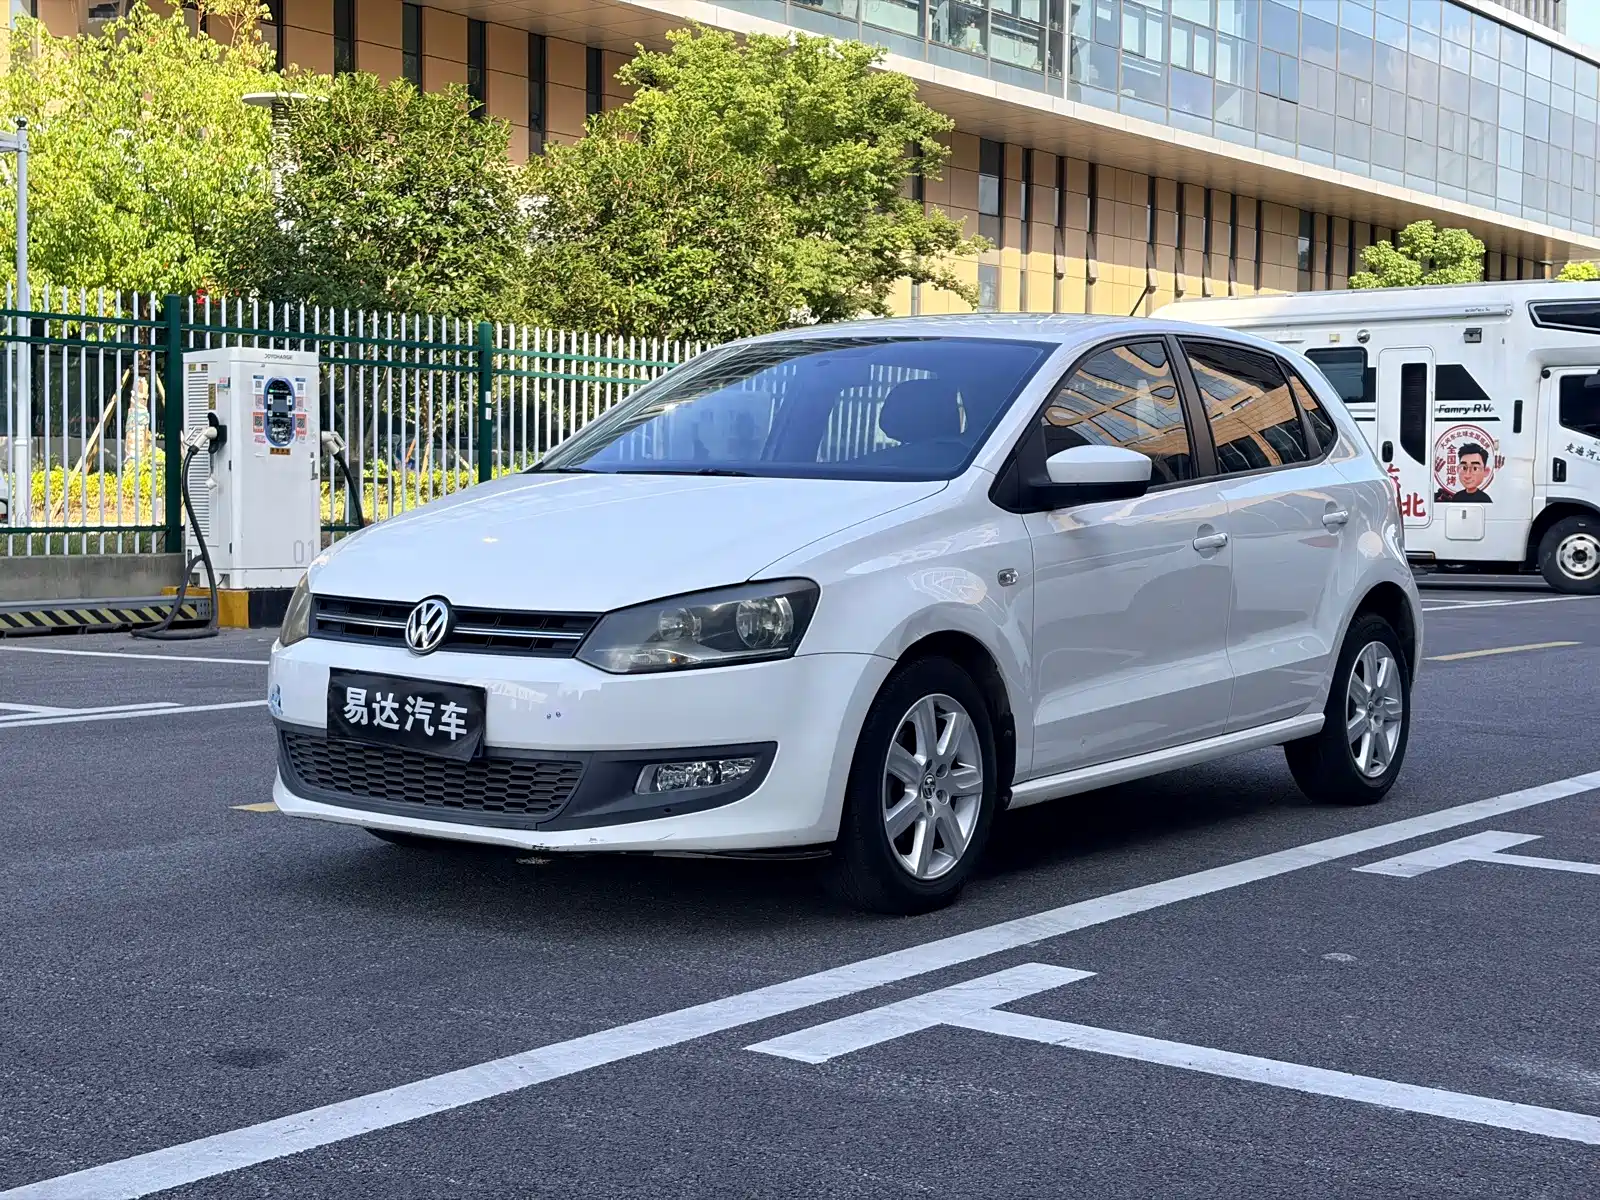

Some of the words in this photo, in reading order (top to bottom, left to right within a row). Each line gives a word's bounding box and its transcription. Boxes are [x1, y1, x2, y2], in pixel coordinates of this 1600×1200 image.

[1438, 404, 1471, 415] Famry
[1446, 444, 1457, 487] 全国巡烤
[343, 686, 468, 741] 易达汽车
